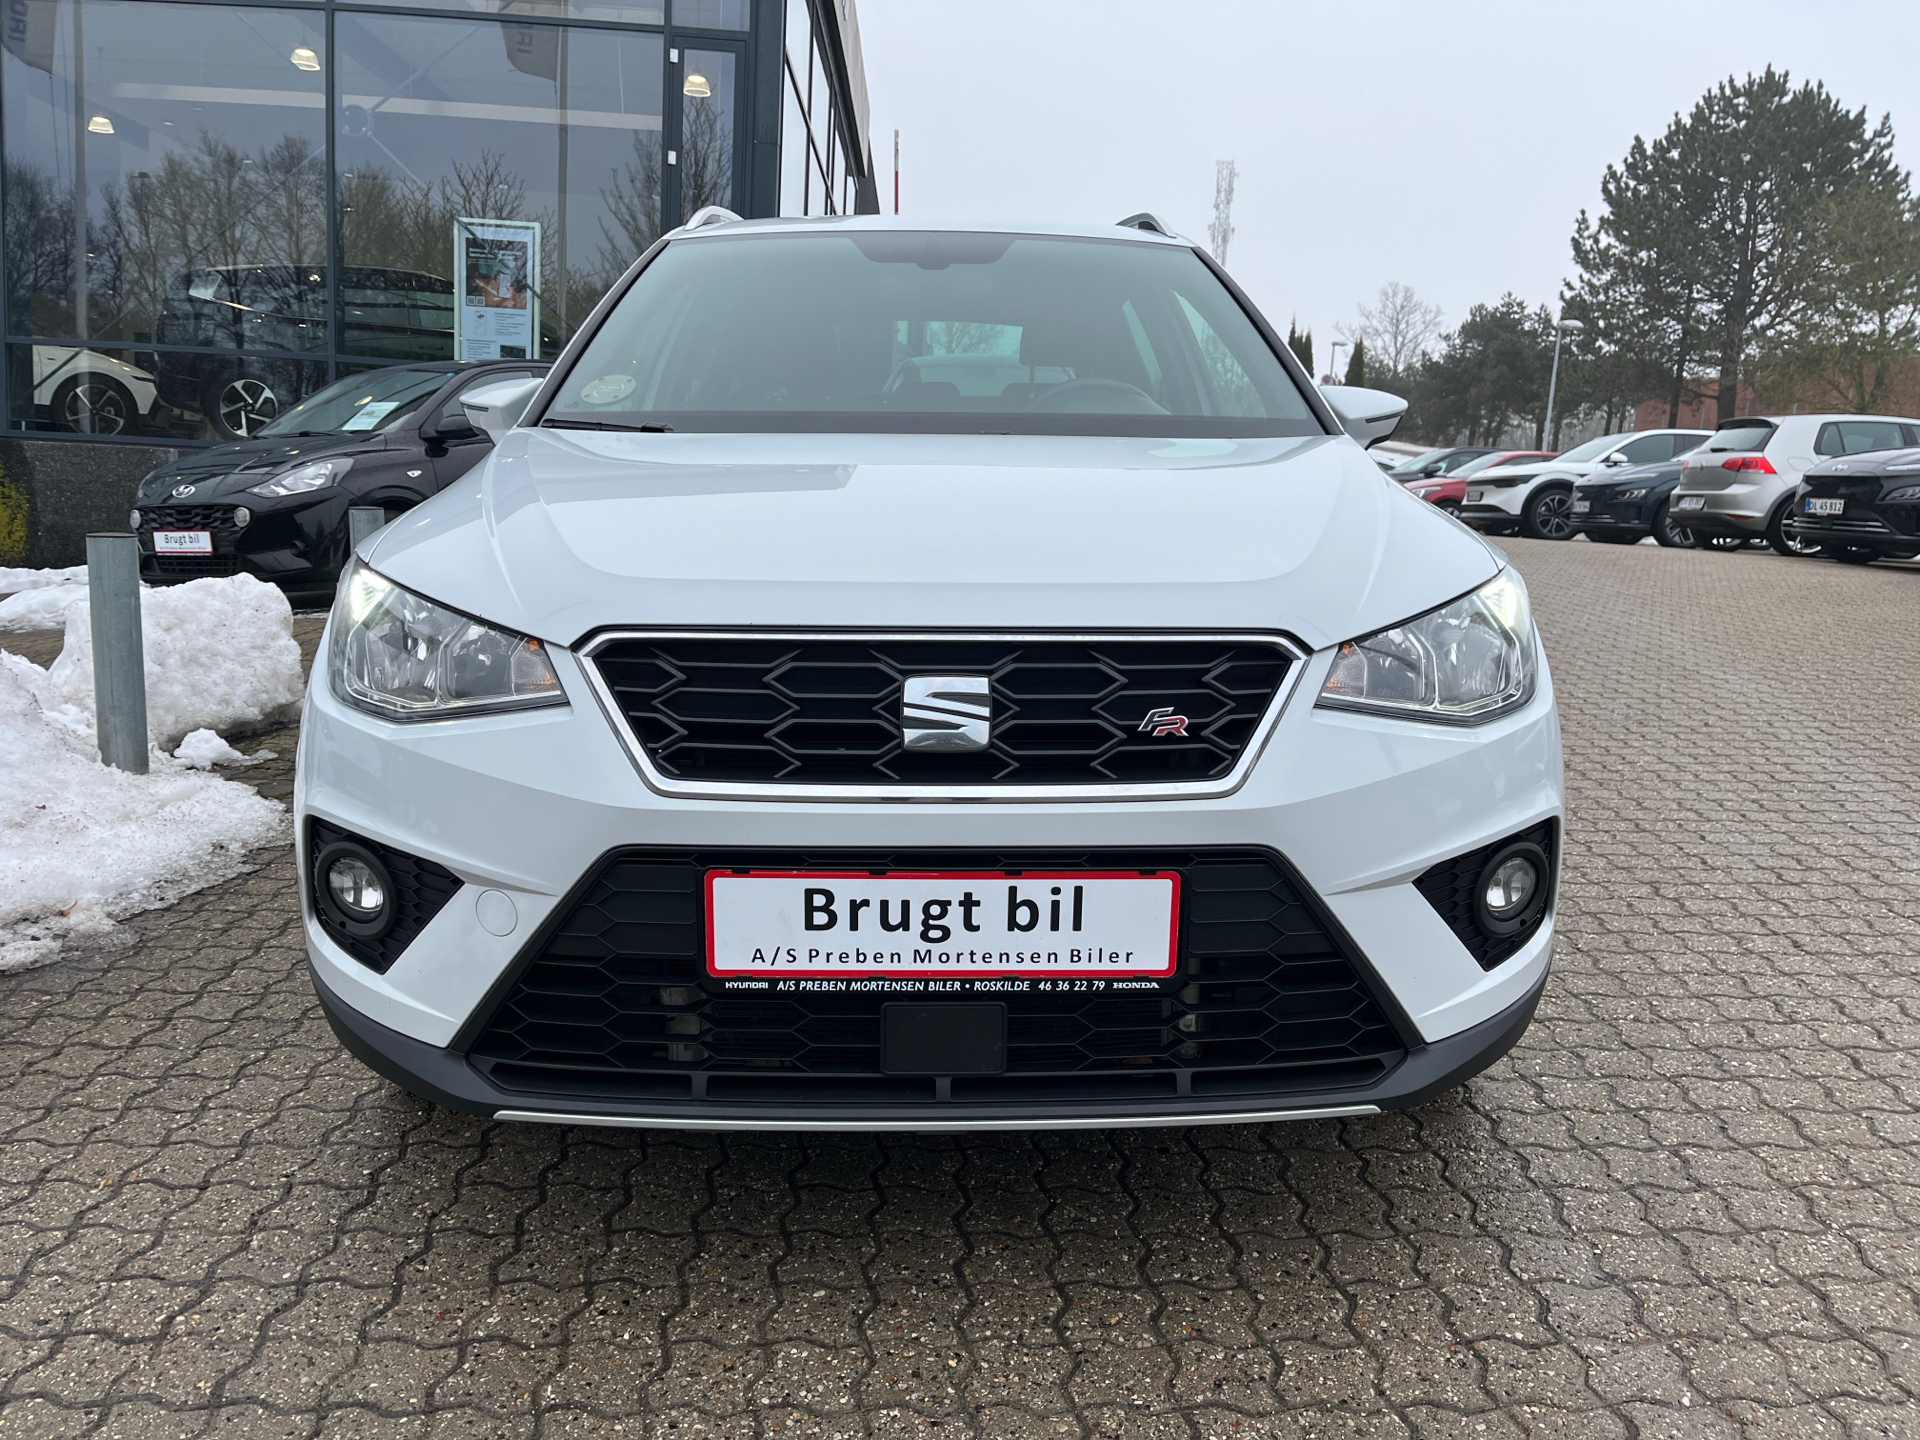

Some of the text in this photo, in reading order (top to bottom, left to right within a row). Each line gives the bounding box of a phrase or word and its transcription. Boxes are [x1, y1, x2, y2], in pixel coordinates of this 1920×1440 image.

[164, 533, 200, 546] Brugt bil
[1137, 706, 1189, 737] FR
[804, 885, 1084, 944] Brugt bil
[751, 946, 1134, 967] A/S Preben Mortensen Biler
[725, 980, 1160, 991] HYUNDAI A/S PREBEN MORTENSEN BILER ROSKILDE 46 36 22 79 HONDA
